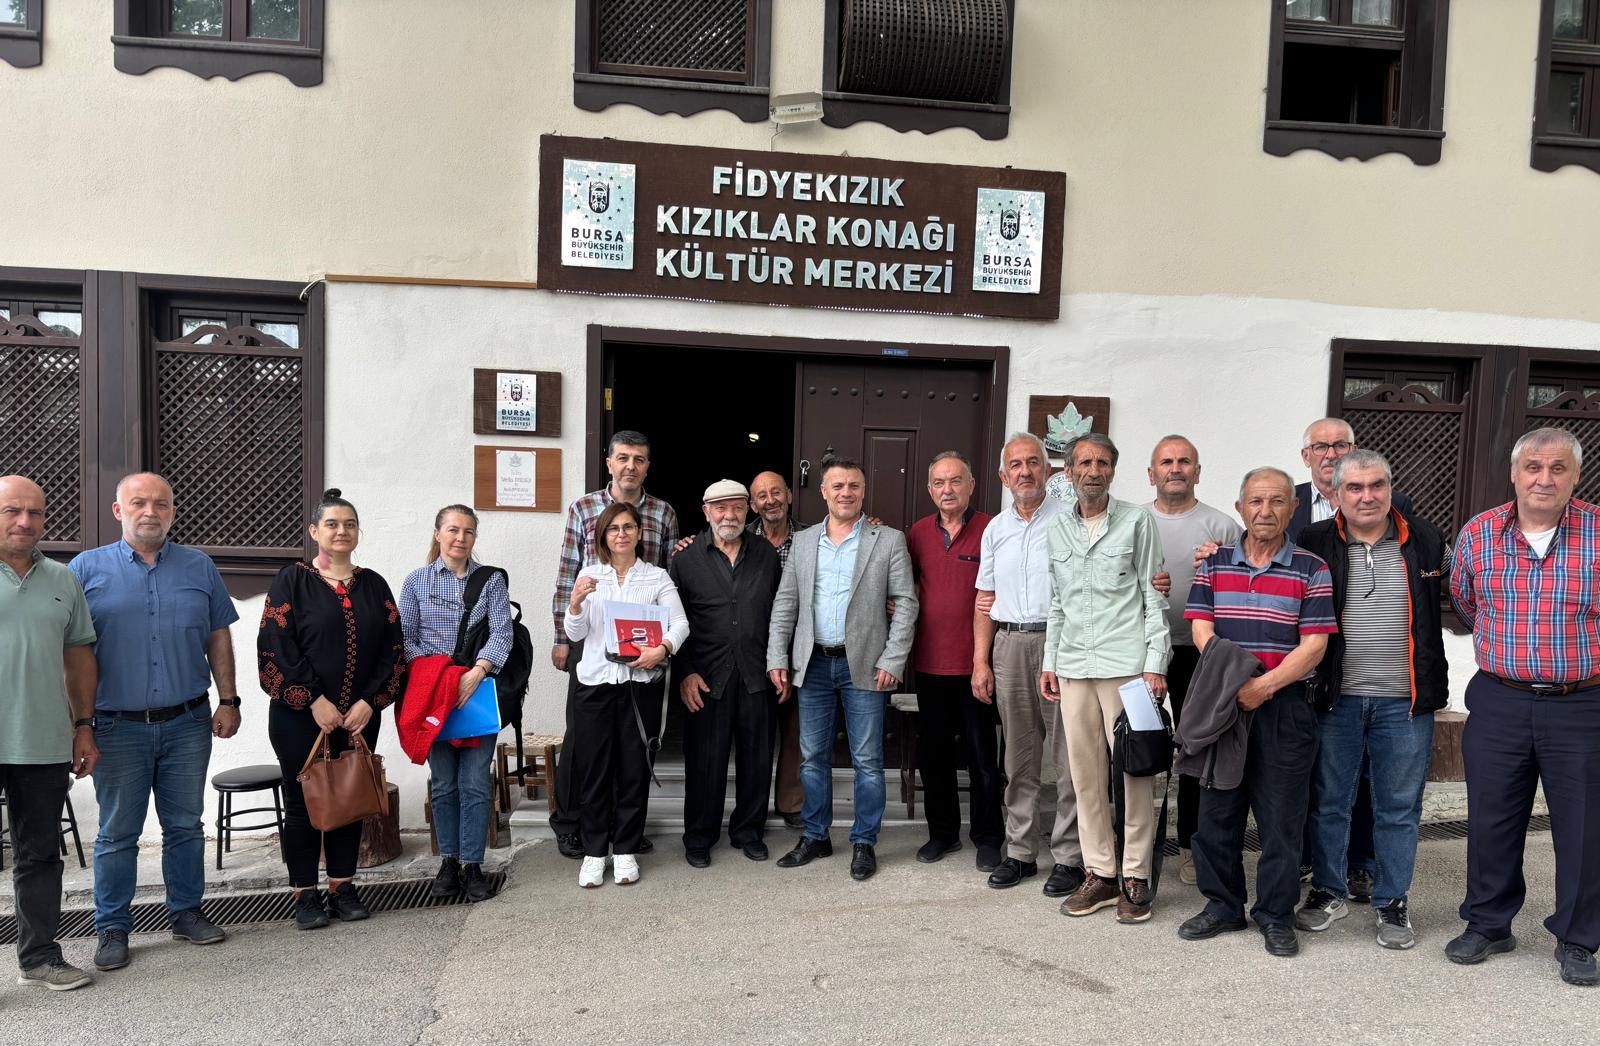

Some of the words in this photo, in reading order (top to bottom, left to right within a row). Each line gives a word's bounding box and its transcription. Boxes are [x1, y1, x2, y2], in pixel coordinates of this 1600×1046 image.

[712, 161, 905, 207] FİDYEKIZIK
[571, 227, 624, 243] BURSA
[656, 204, 817, 244] KIZIKLAR
[826, 215, 955, 252] KONAĞI
[571, 251, 624, 261] BELEDİYESİ
[982, 254, 1032, 268] BURSA
[656, 242, 794, 285] KÜLTÜR
[804, 257, 953, 294] MERKEZİ
[501, 408, 531, 417] BURSA
